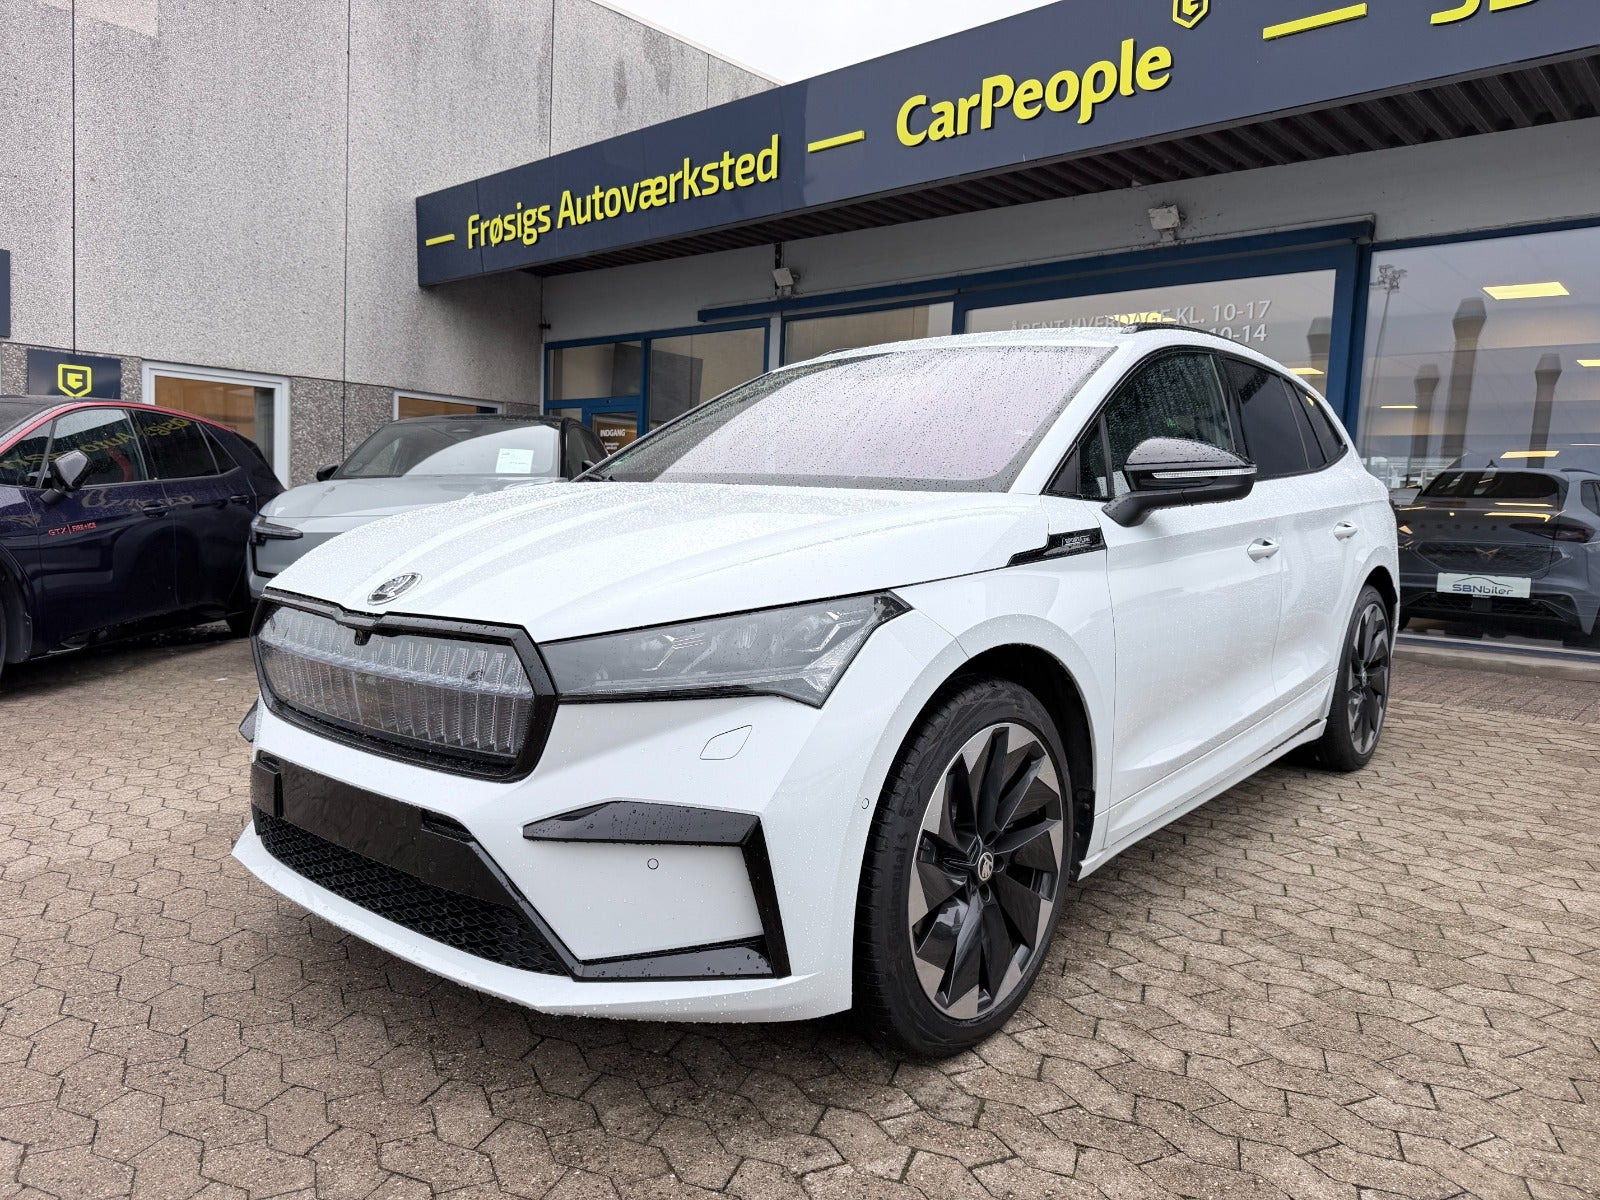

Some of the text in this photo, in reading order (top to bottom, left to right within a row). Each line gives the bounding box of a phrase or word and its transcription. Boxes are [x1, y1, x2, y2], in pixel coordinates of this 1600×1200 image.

[897, 39, 1172, 147] CarPeople
[467, 133, 780, 249] Frøsigs Autoværksted
[1176, 306, 1205, 325] KL.
[1212, 300, 1272, 322] 10-17
[600, 429, 626, 437] INDGANG
